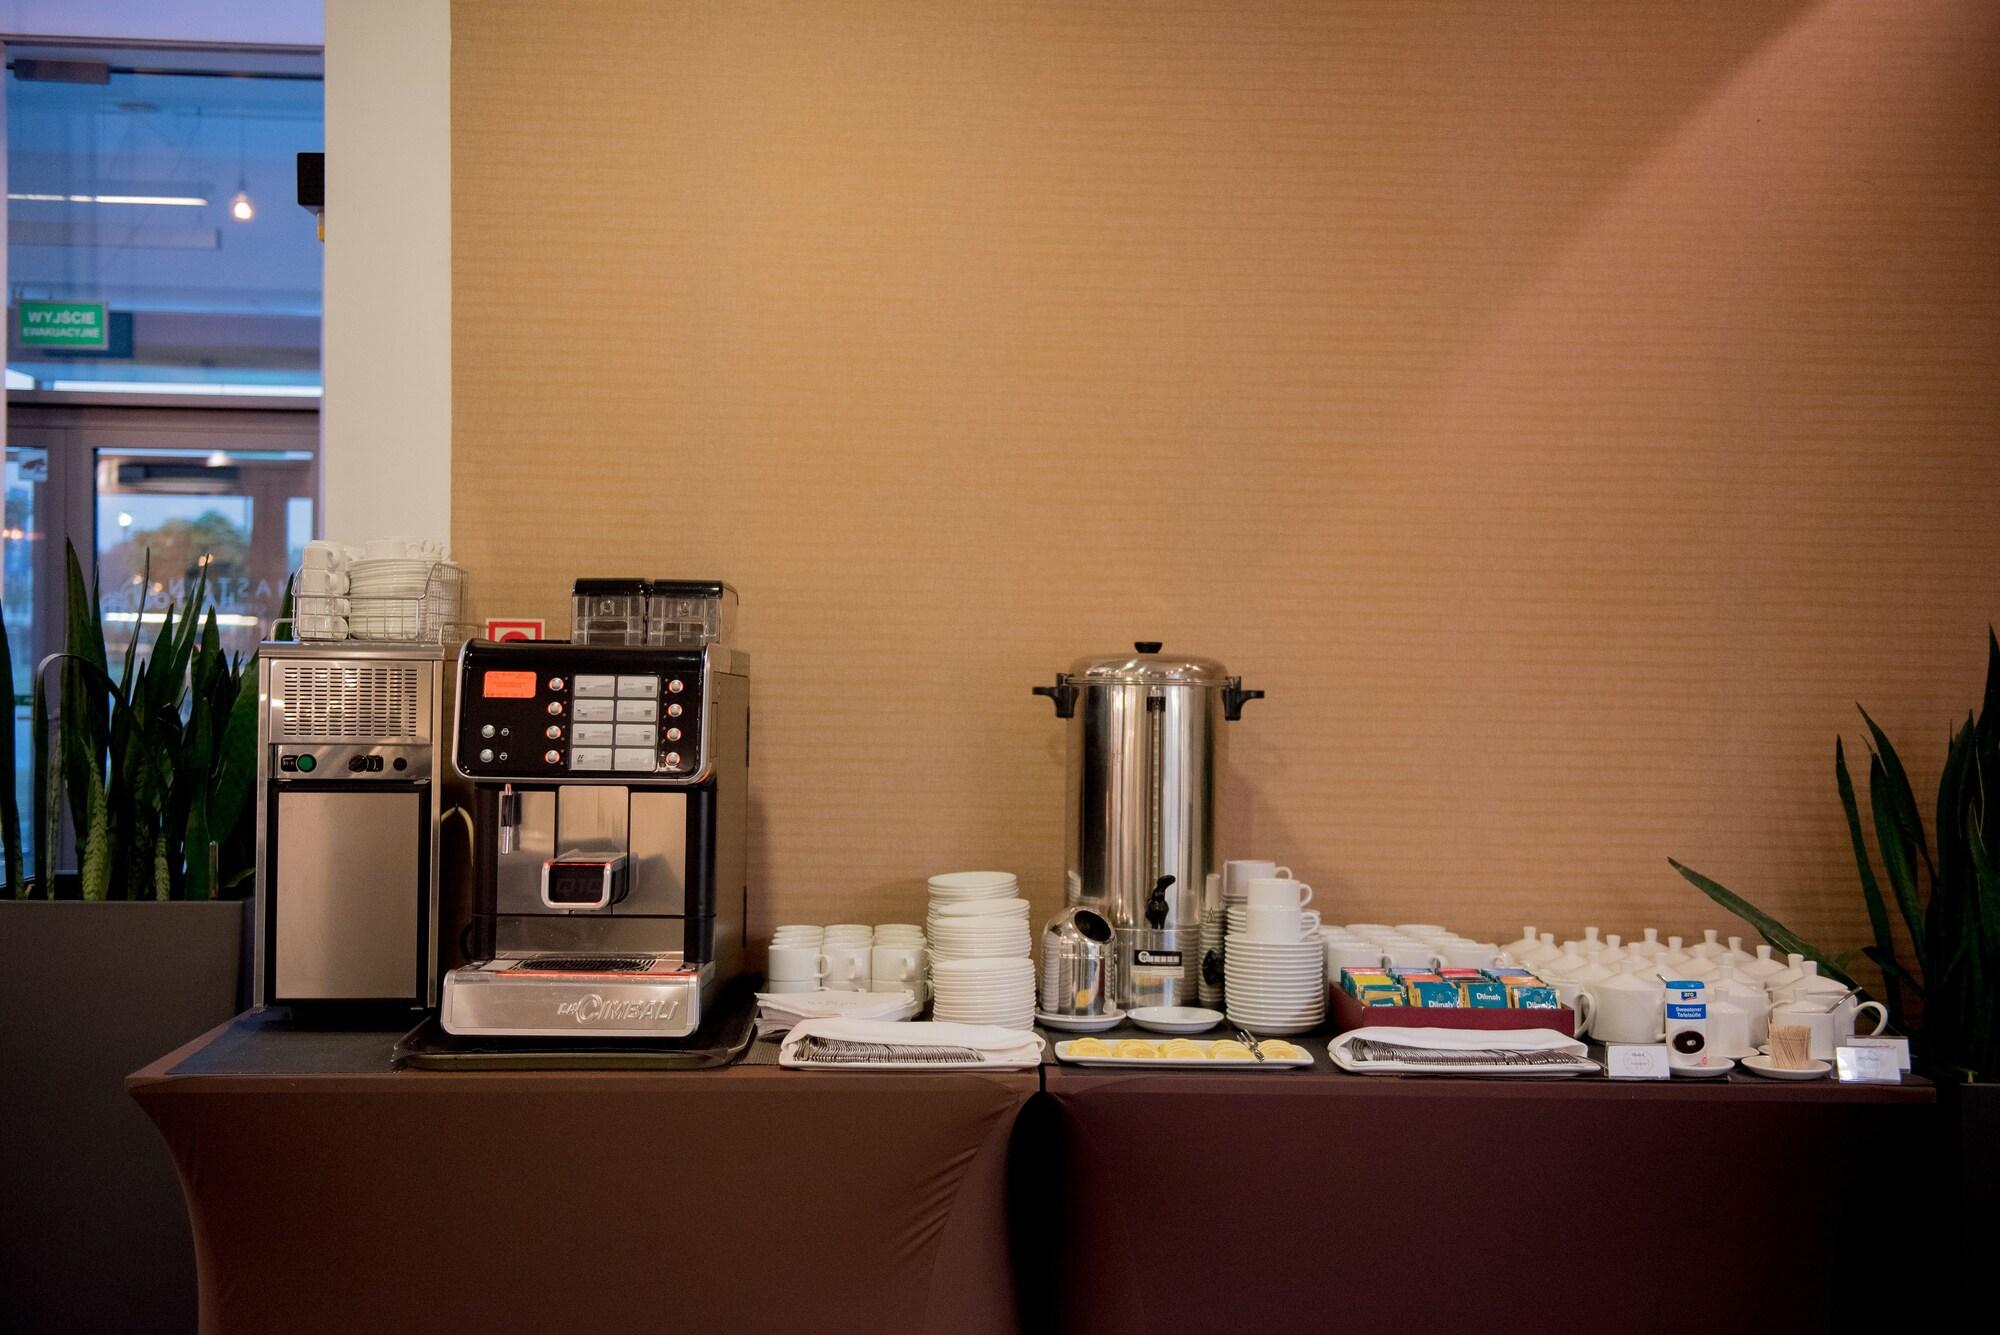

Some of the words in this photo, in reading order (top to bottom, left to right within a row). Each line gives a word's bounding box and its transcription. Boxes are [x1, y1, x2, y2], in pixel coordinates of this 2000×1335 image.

[27, 310, 96, 325] WYJŚCIE
[1476, 992, 1501, 1001] Dilmah
[576, 993, 678, 1024] CIMBALI
